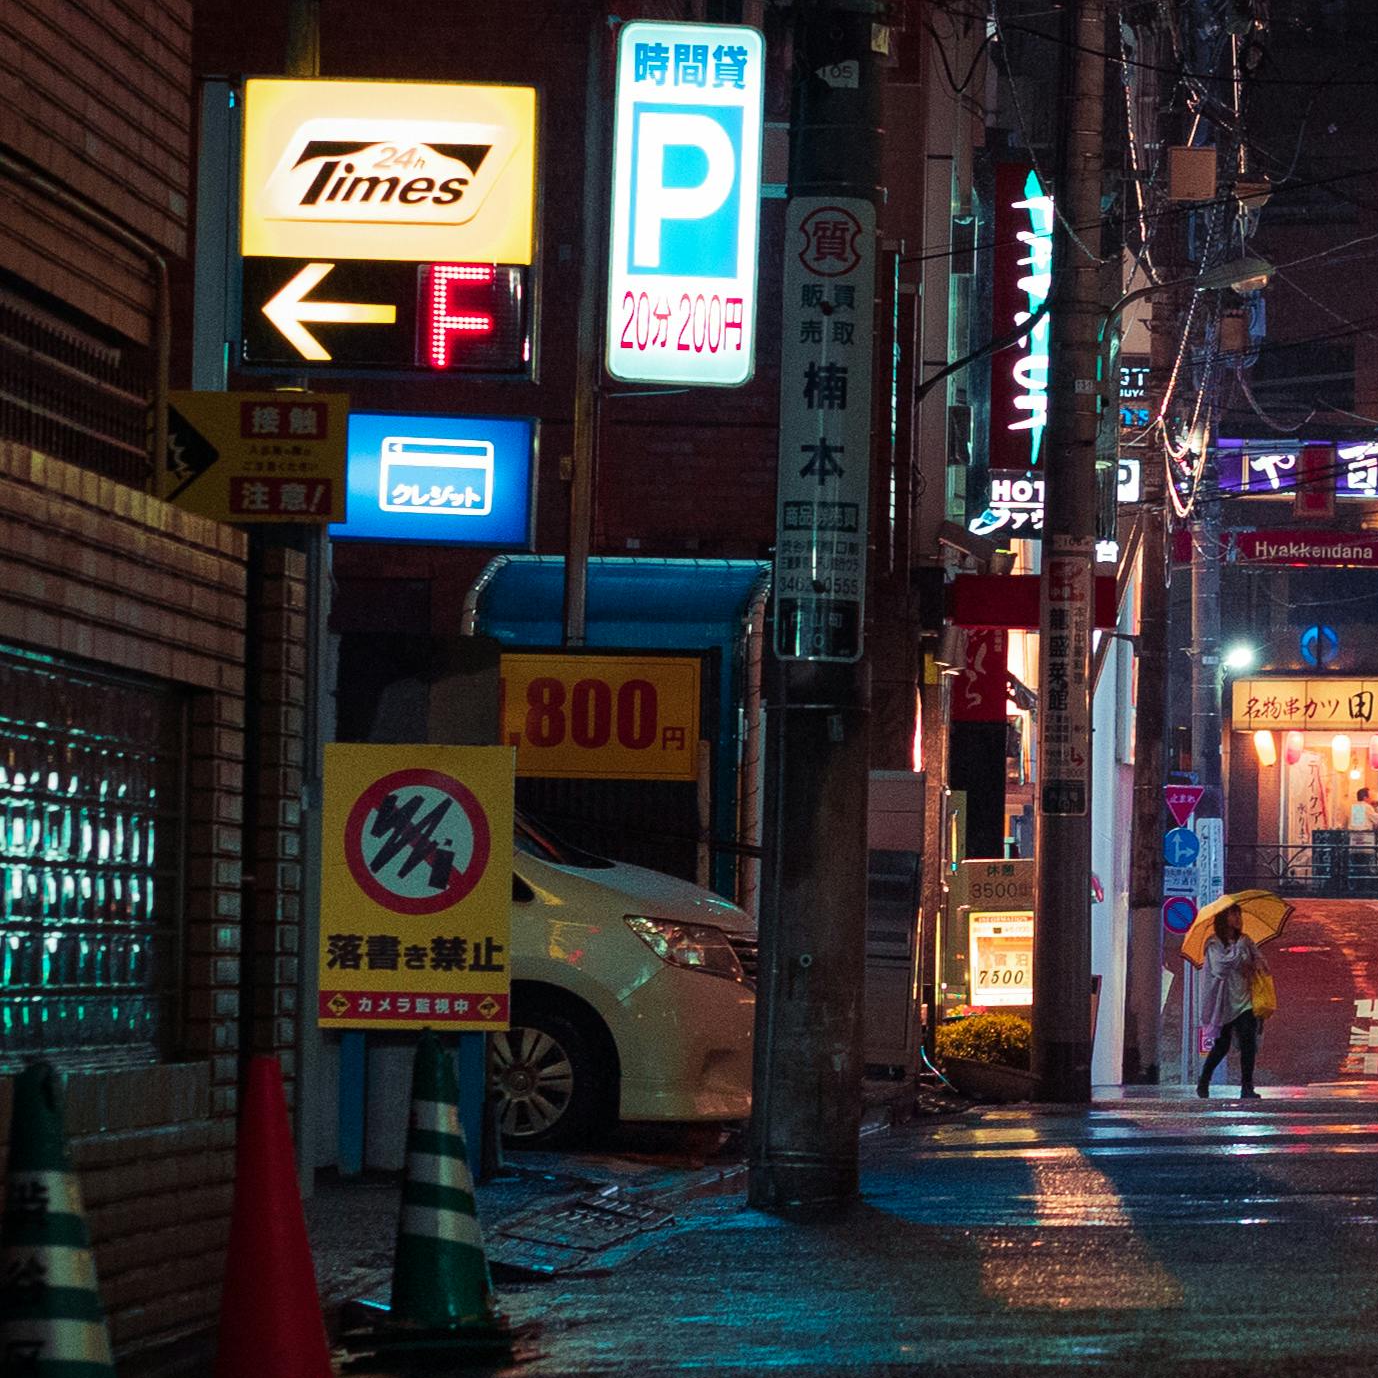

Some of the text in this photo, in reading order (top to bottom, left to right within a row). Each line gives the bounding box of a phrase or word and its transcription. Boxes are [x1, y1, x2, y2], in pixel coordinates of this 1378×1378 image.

[634, 42, 749, 90] 時間貸
[290, 139, 495, 208] Times
[634, 110, 736, 271] P
[812, 220, 850, 263] 質
[430, 263, 491, 368] F
[620, 290, 744, 354] 20分 200円
[251, 404, 319, 436] 接触
[799, 361, 849, 486] 楠本
[390, 482, 482, 510] クレジット
[1254, 541, 1374, 560] Hyakkendana
[501, 677, 685, 753] ,800円
[1307, 758, 1324, 829] テイクア
[326, 934, 504, 975] 落書き禁止
[979, 969, 1025, 986] 7500
[357, 995, 470, 1016] カメラ監視中
